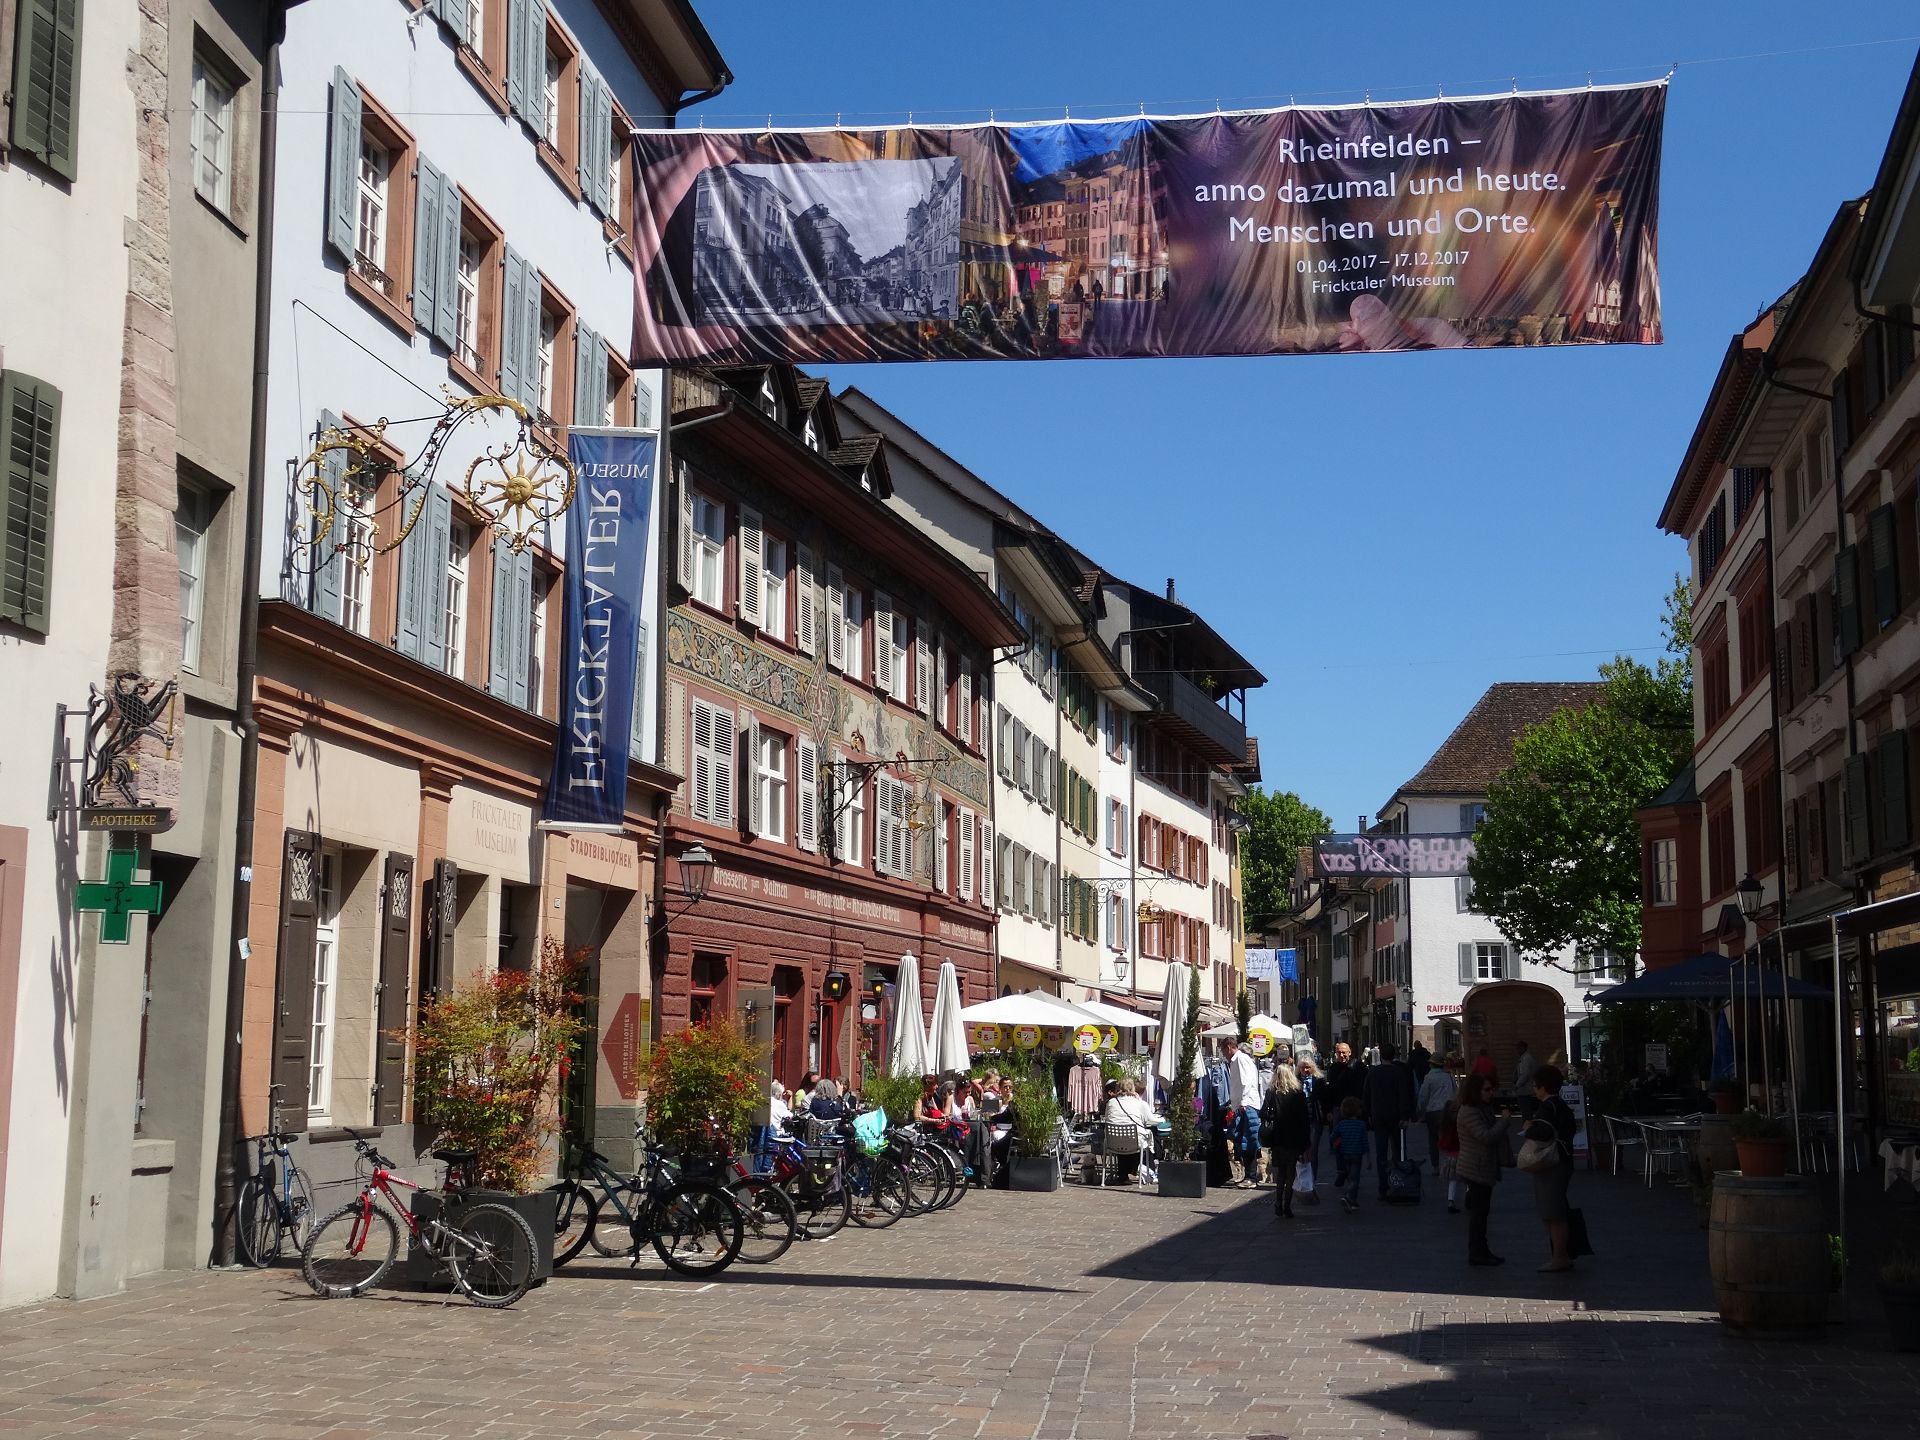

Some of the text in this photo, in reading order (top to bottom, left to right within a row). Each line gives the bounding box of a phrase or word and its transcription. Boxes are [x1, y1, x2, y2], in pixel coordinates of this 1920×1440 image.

[1279, 134, 1449, 164] Rheinfelden
[1195, 166, 1566, 203] anno dazumal und heute.
[1229, 207, 1536, 246] Menschen und Orte.
[1296, 254, 1377, 274] 01.04.2017
[1395, 250, 1470, 267] 17.12.2017
[1312, 273, 1455, 294] Fricktaler Museum
[90, 815, 157, 826] APOTHEKE
[471, 800, 522, 832] FRICKTALER
[475, 829, 517, 856] MUSEUM
[570, 838, 632, 868] STADTBIBLIOTHEK
[1426, 1004, 1463, 1013] RAIFFEIS
